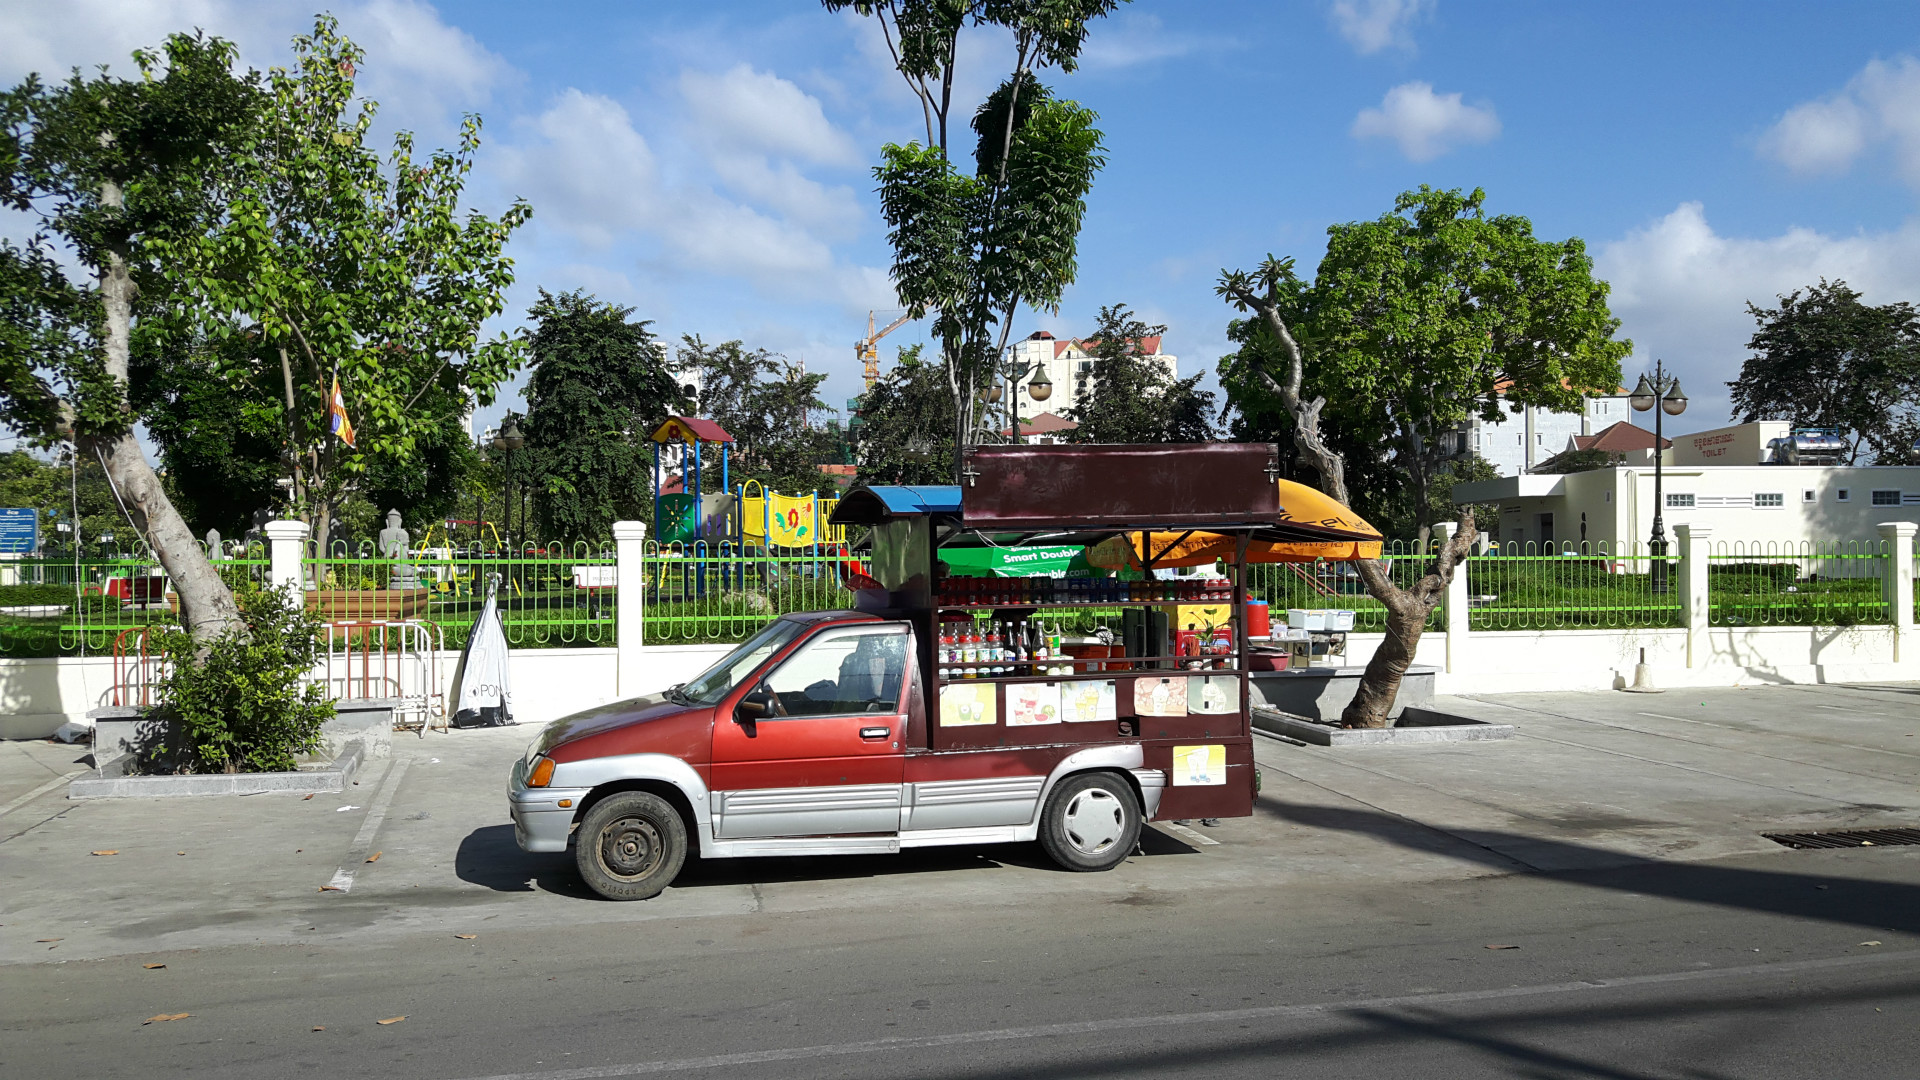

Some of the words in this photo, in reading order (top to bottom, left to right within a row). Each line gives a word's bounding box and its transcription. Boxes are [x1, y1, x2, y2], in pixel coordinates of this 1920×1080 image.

[1702, 447, 1727, 458] TOILET
[1003, 552, 1038, 563] Smart
[1040, 549, 1080, 560] Double
[601, 882, 637, 896] APOLLO
